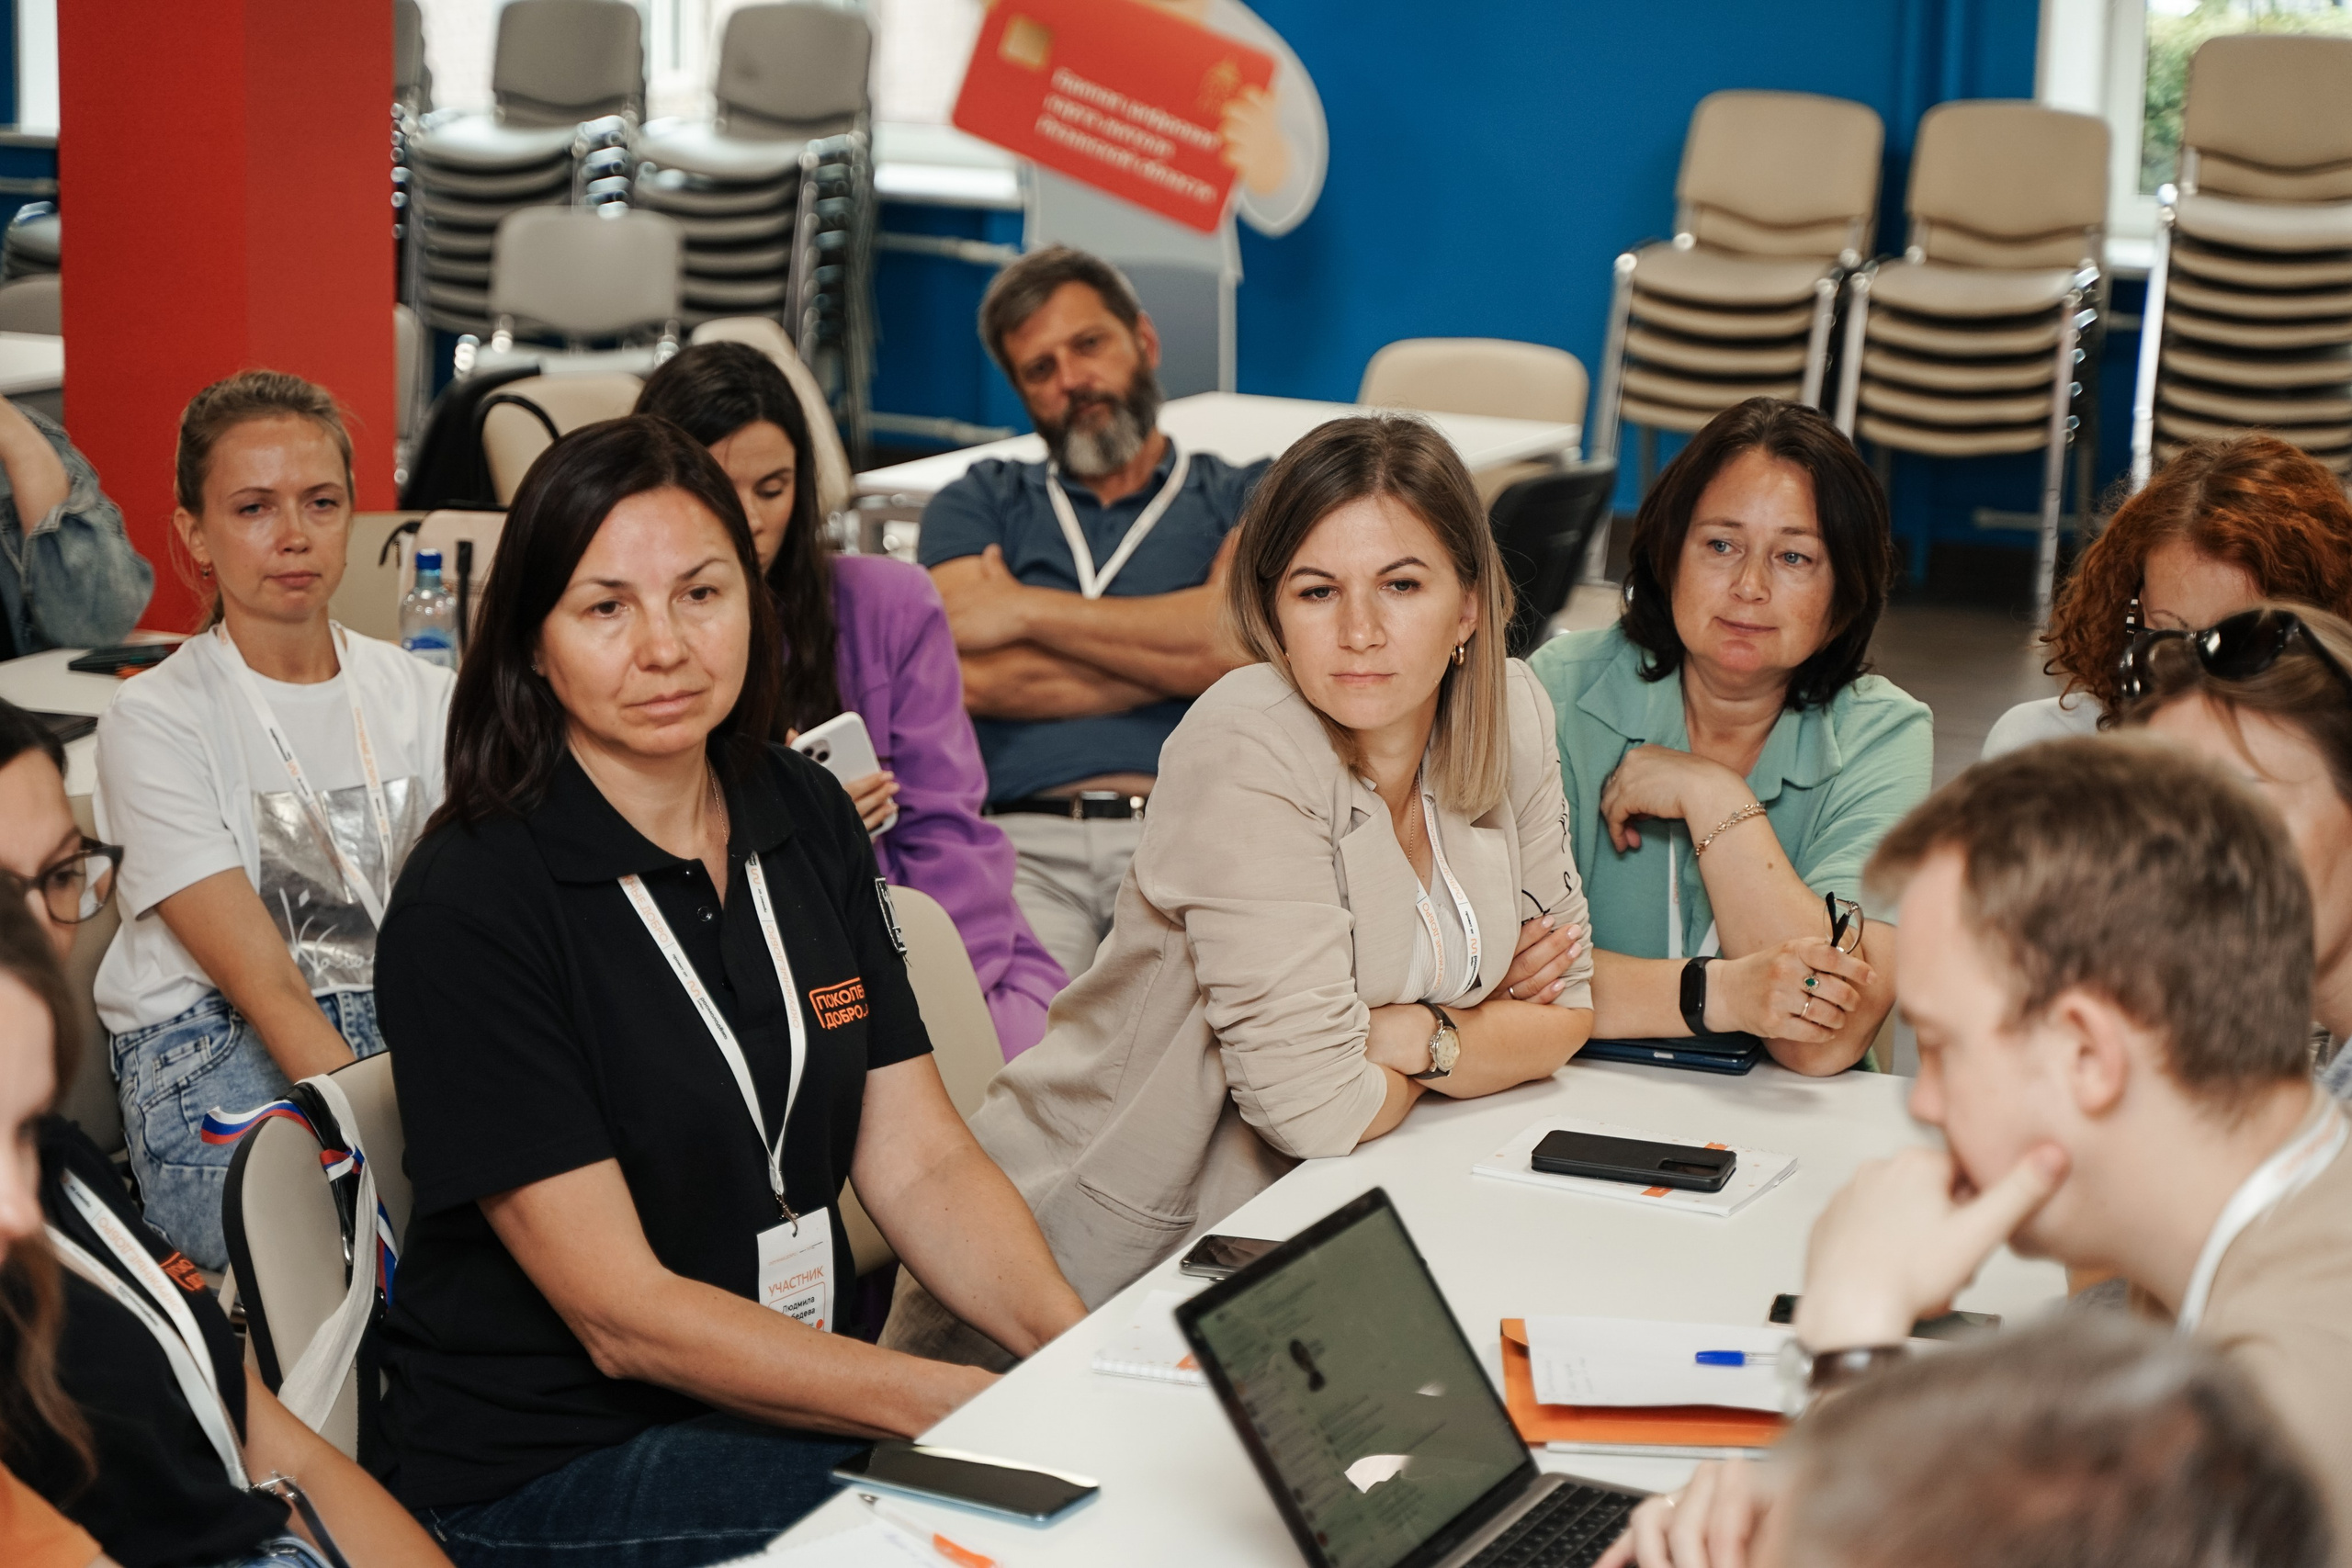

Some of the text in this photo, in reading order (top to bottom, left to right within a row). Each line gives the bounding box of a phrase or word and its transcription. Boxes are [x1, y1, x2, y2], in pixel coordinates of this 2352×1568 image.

[815, 984, 865, 1010] ПОКОЛЕ
[768, 1265, 824, 1297] УЧАСТНИК
[782, 1296, 815, 1314] Людмила
[791, 1307, 816, 1320] бедева
